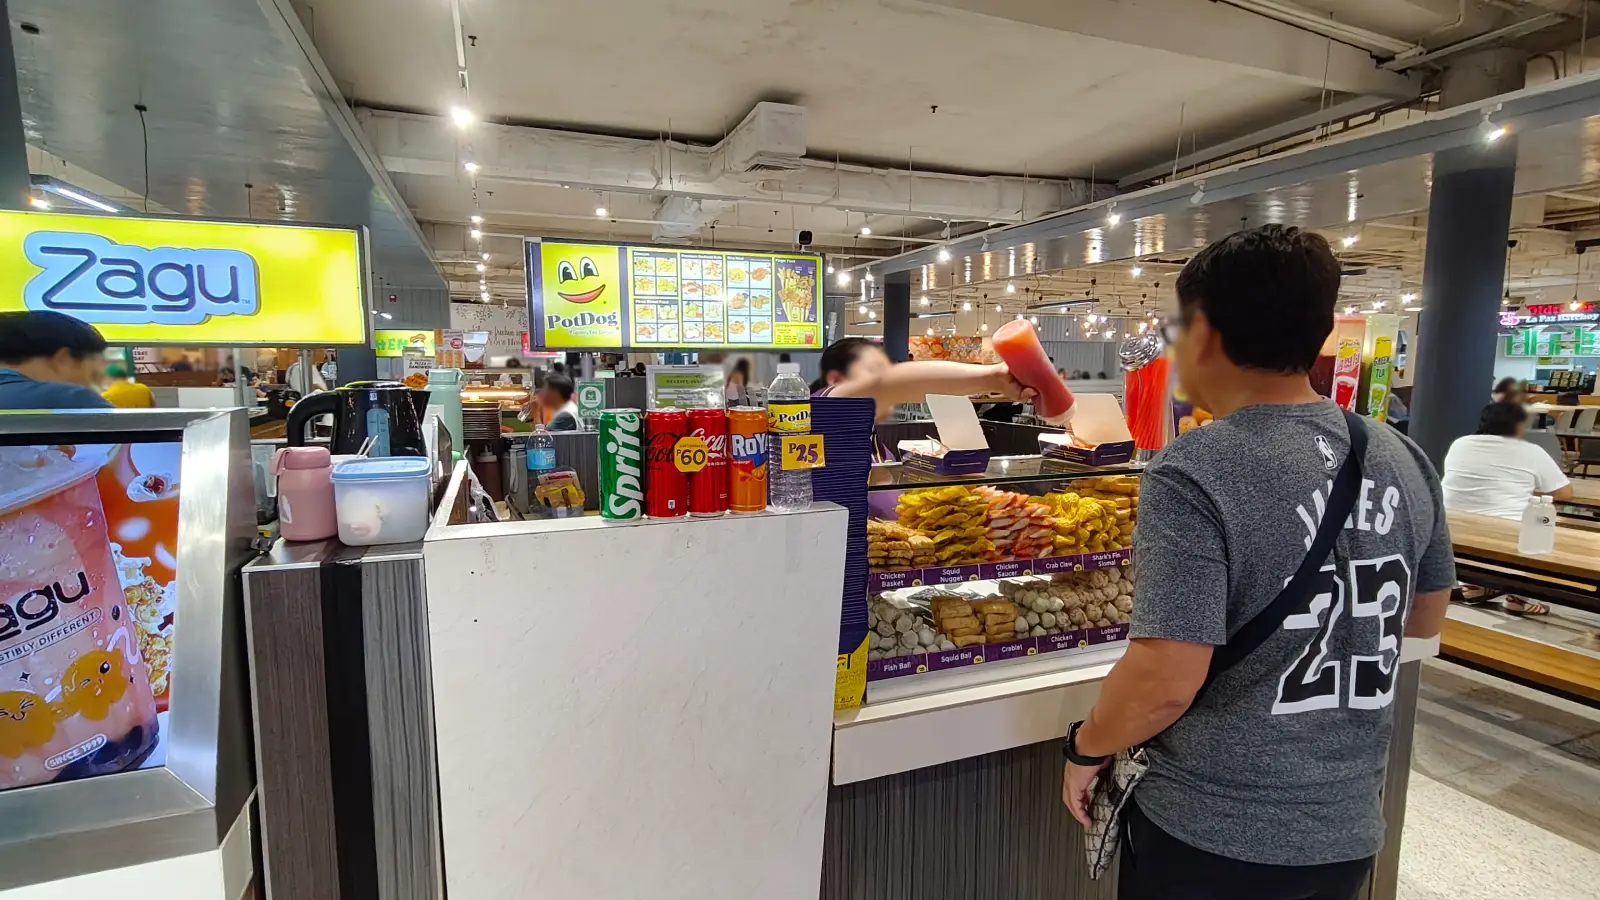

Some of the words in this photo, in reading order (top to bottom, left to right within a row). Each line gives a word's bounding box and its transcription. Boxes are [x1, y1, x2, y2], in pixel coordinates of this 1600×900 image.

[40, 245, 240, 312] Zagu
[547, 311, 619, 329] PotDog
[778, 410, 810, 423] PotD
[608, 412, 644, 520] Sprite
[995, 563, 1018, 571] Chicken
[1045, 561, 1058, 569] Crab
[880, 572, 906, 580] Chicken
[942, 568, 960, 576] Squid
[881, 579, 904, 588] Basket
[940, 575, 963, 583] Nugget
[0, 571, 90, 642] agu
[38, 611, 97, 647] DIFFERENT
[1100, 626, 1121, 635] Lobster
[1271, 553, 1411, 715] 23
[1051, 634, 1073, 643] Chicken
[1057, 641, 1068, 649] Ball
[941, 653, 960, 663] Squid
[960, 652, 972, 660] Ball
[883, 663, 898, 672] Fish
[899, 661, 912, 670] Ball
[49, 749, 80, 768] SINCE
[81, 736, 103, 752] 1999
